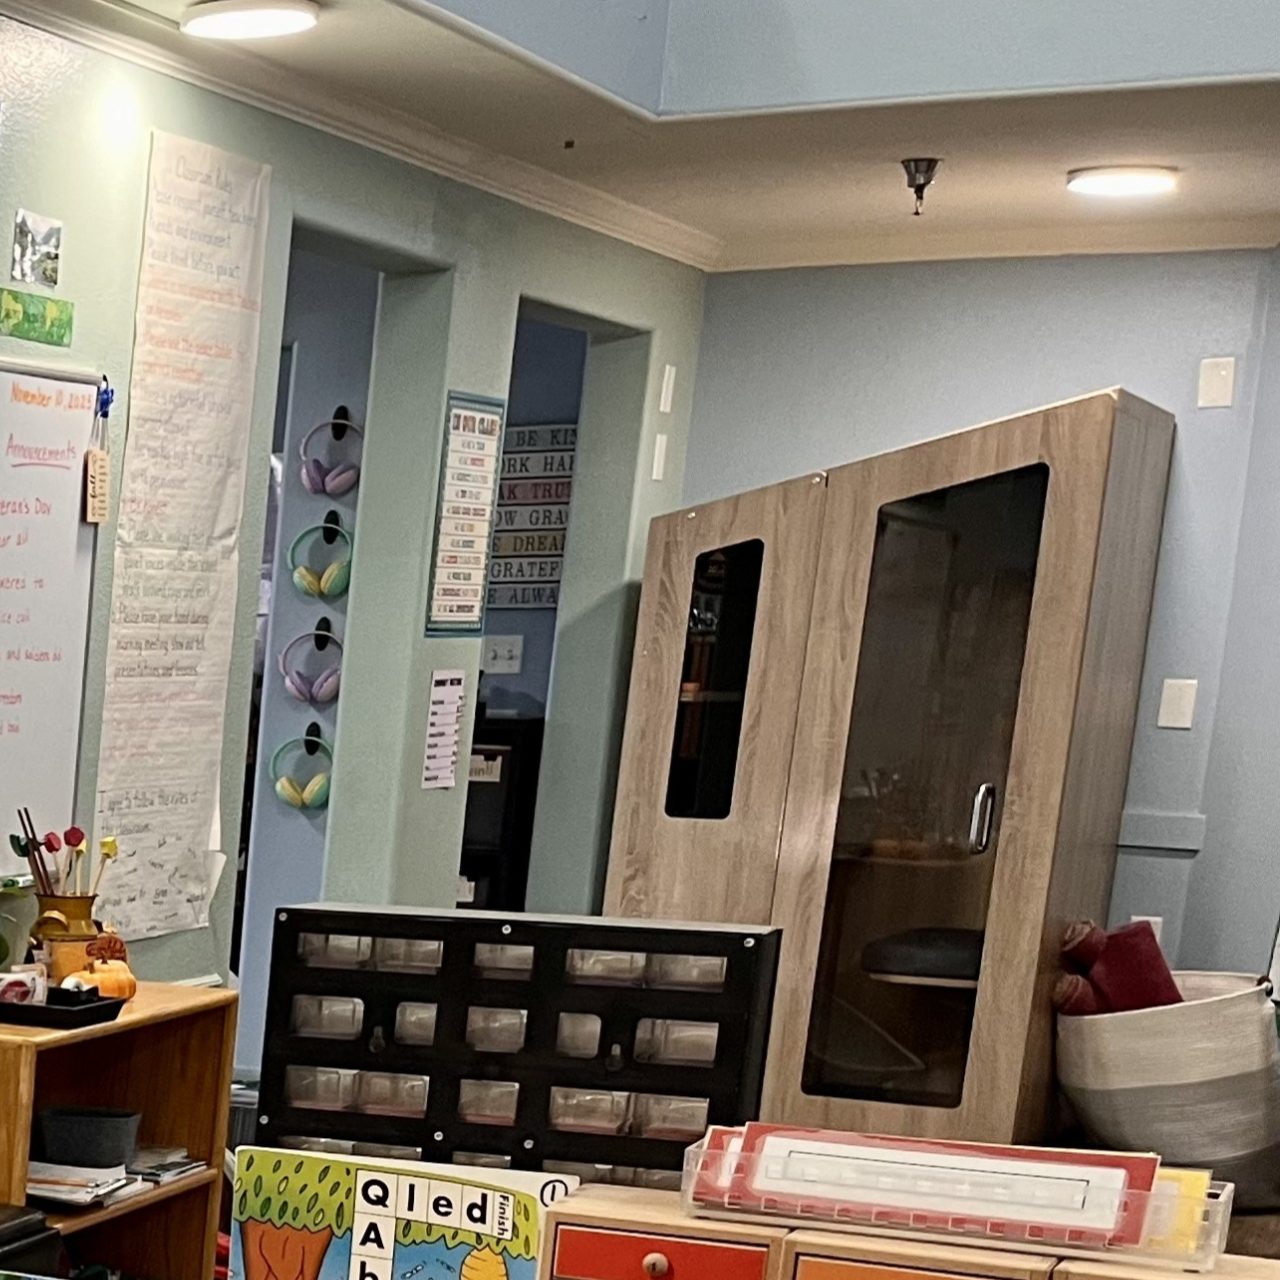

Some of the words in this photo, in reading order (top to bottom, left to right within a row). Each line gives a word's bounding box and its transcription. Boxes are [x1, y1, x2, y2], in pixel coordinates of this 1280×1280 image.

[516, 430, 538, 447] BE
[529, 510, 568, 526] GRA
[361, 1179, 390, 1208] Q
[432, 1195, 453, 1217] e
[466, 1193, 488, 1225] d
[496, 1193, 510, 1238] Finish
[359, 1222, 385, 1250] A
